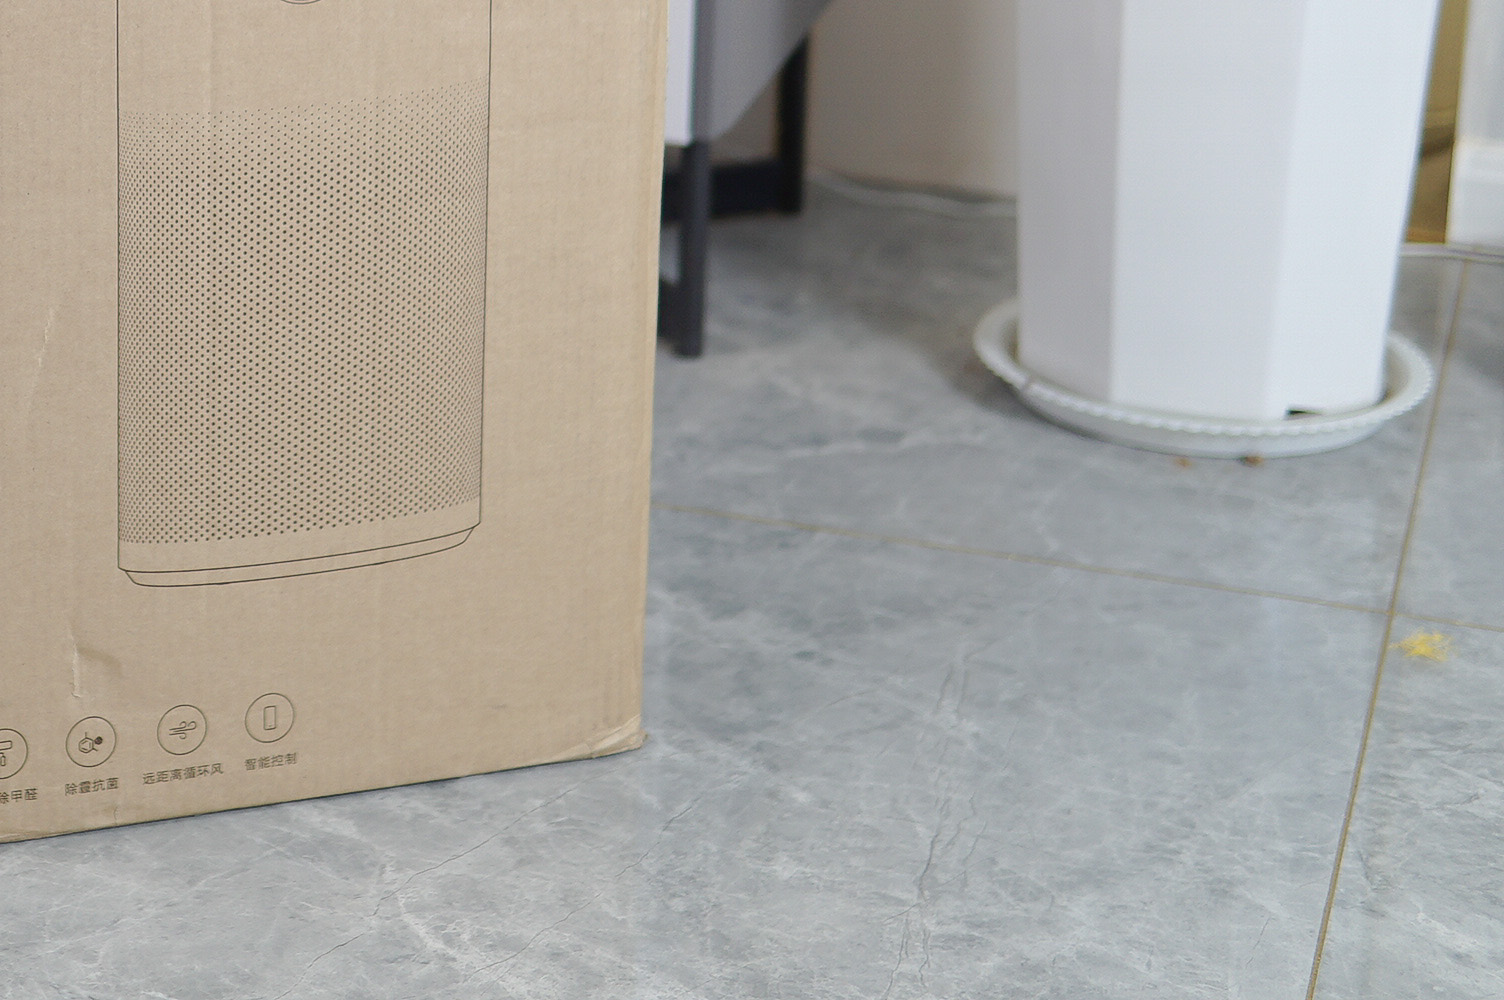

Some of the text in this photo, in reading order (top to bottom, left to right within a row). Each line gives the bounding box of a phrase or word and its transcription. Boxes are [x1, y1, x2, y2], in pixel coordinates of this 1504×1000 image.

[244, 752, 297, 771] 智能控制
[142, 762, 224, 785] 远距离循环风
